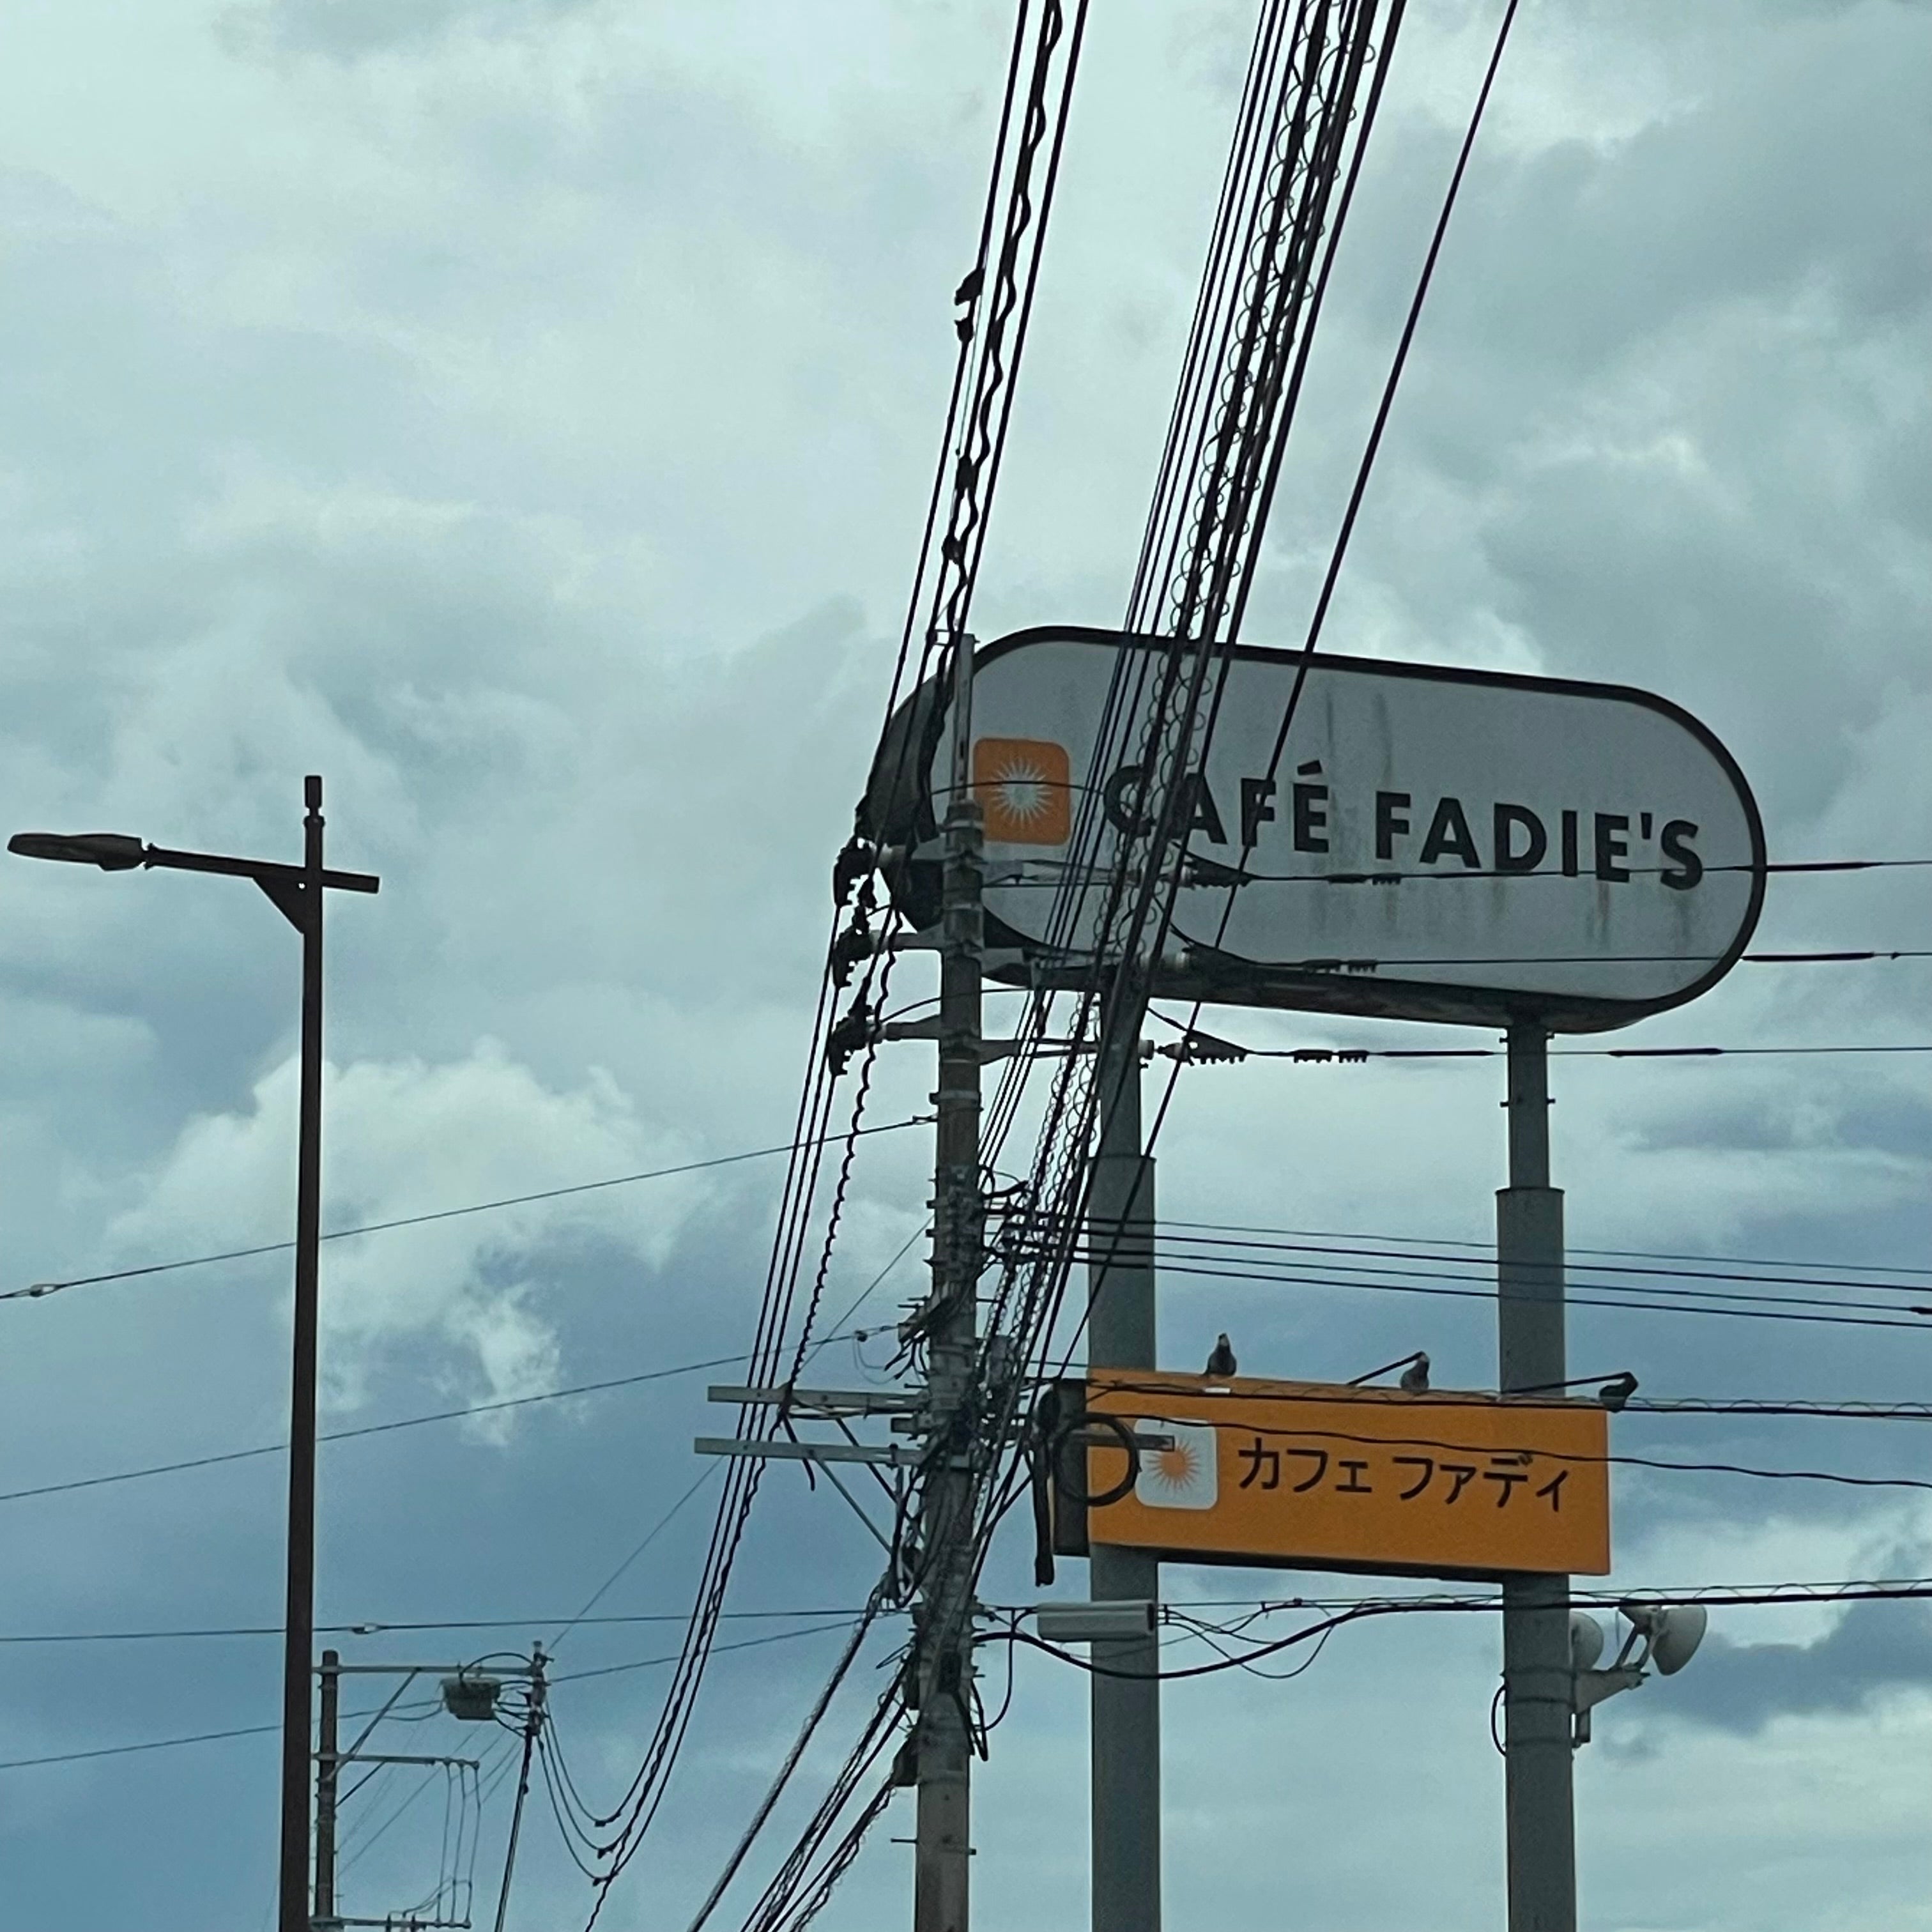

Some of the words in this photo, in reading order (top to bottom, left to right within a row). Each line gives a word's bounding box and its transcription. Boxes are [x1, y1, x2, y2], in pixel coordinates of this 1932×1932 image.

[1104, 759, 1330, 854] CAFÉ
[1376, 791, 1703, 891] FADIE'S
[1239, 1438, 1372, 1494] カフェ
[1393, 1452, 1568, 1512] ファディ
